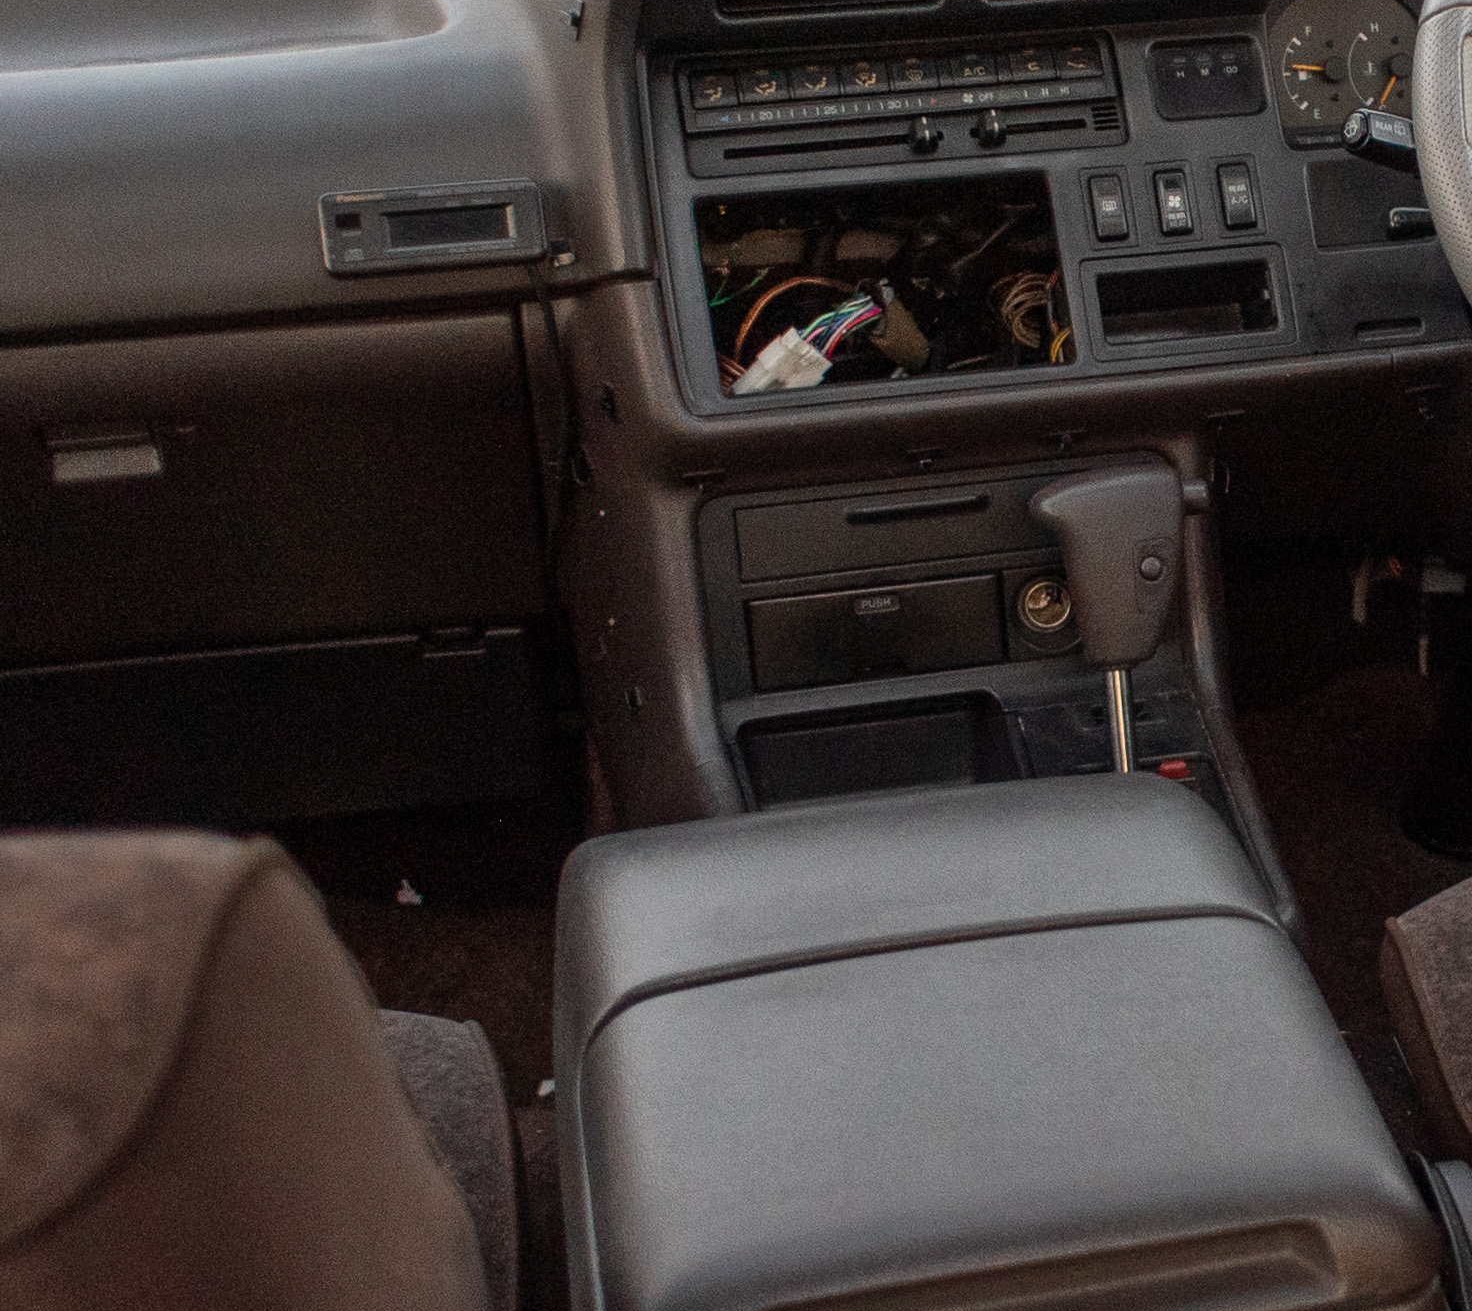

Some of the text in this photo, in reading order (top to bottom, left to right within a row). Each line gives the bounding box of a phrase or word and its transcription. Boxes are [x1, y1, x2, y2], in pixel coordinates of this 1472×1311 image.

[963, 65, 986, 77] A/C
[759, 110, 773, 121] 20
[887, 100, 902, 110] 30
[1374, 120, 1393, 132] REAR
[1231, 195, 1249, 205] A/C
[860, 596, 892, 610] PUSH
